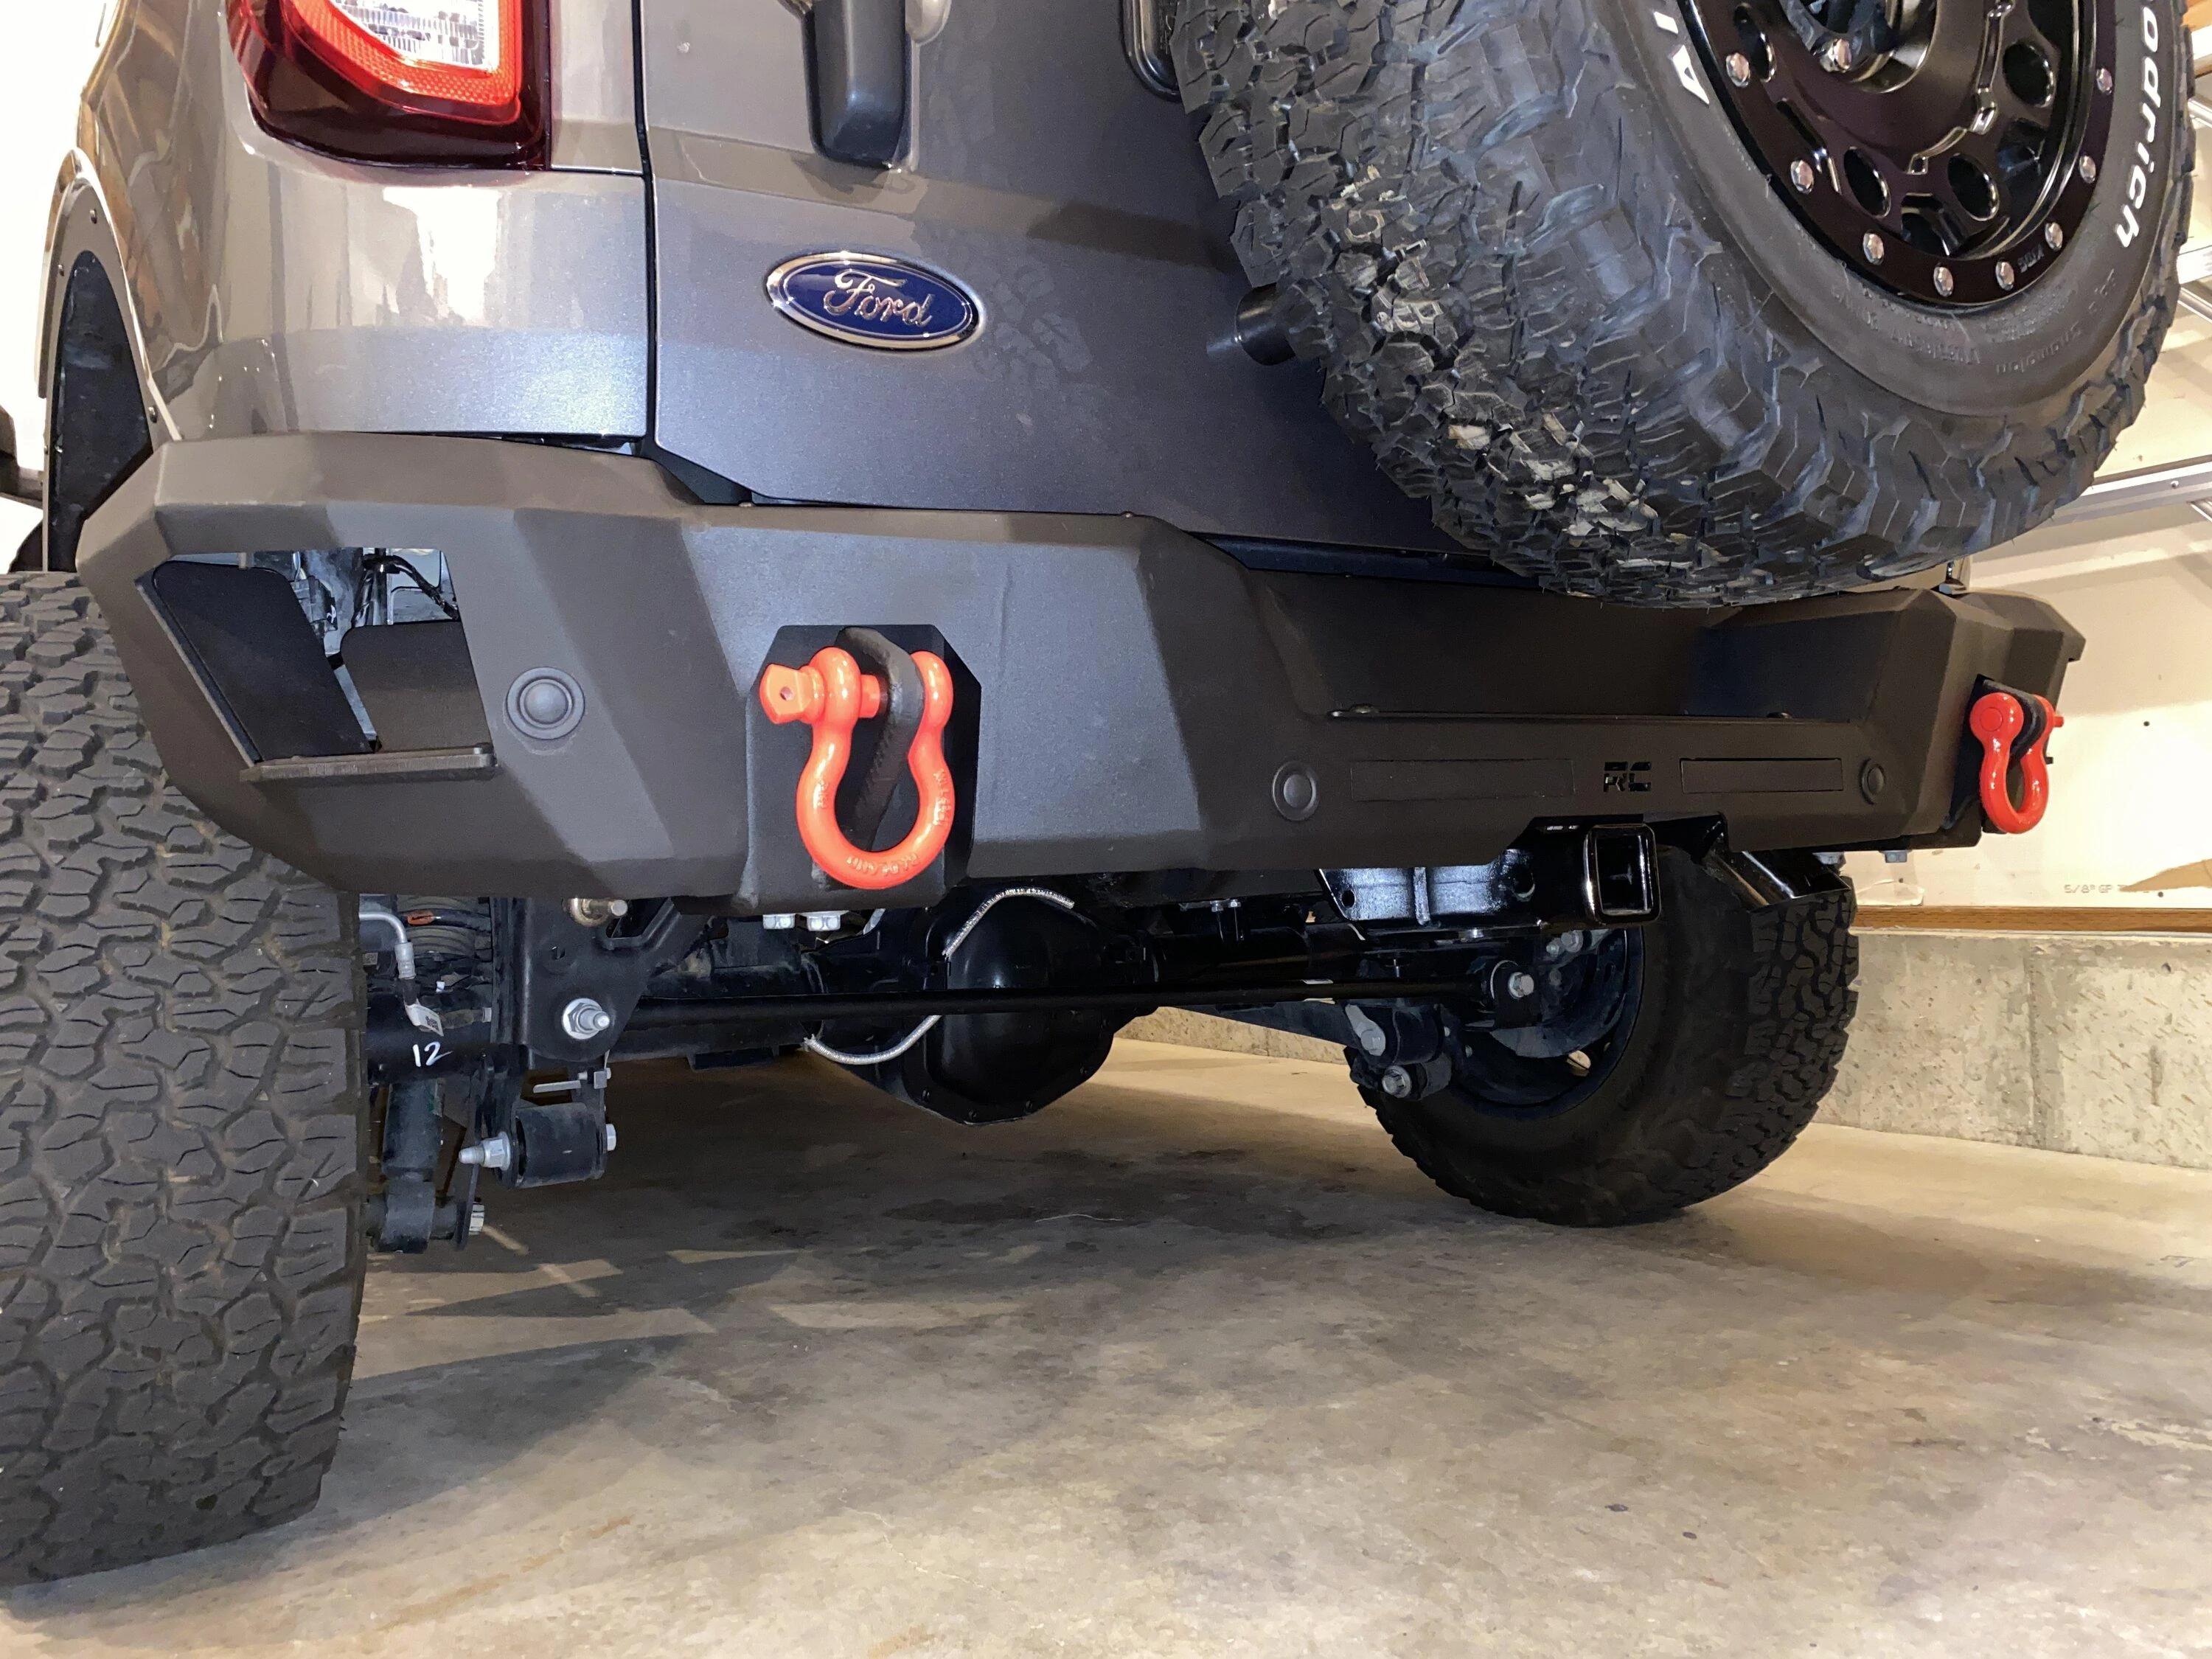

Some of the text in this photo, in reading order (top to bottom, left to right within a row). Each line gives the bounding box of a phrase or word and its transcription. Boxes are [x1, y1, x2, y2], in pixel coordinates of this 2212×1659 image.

[823, 268, 934, 326] Ford
[1603, 762, 1652, 793] RC
[411, 1041, 453, 1068] 12
